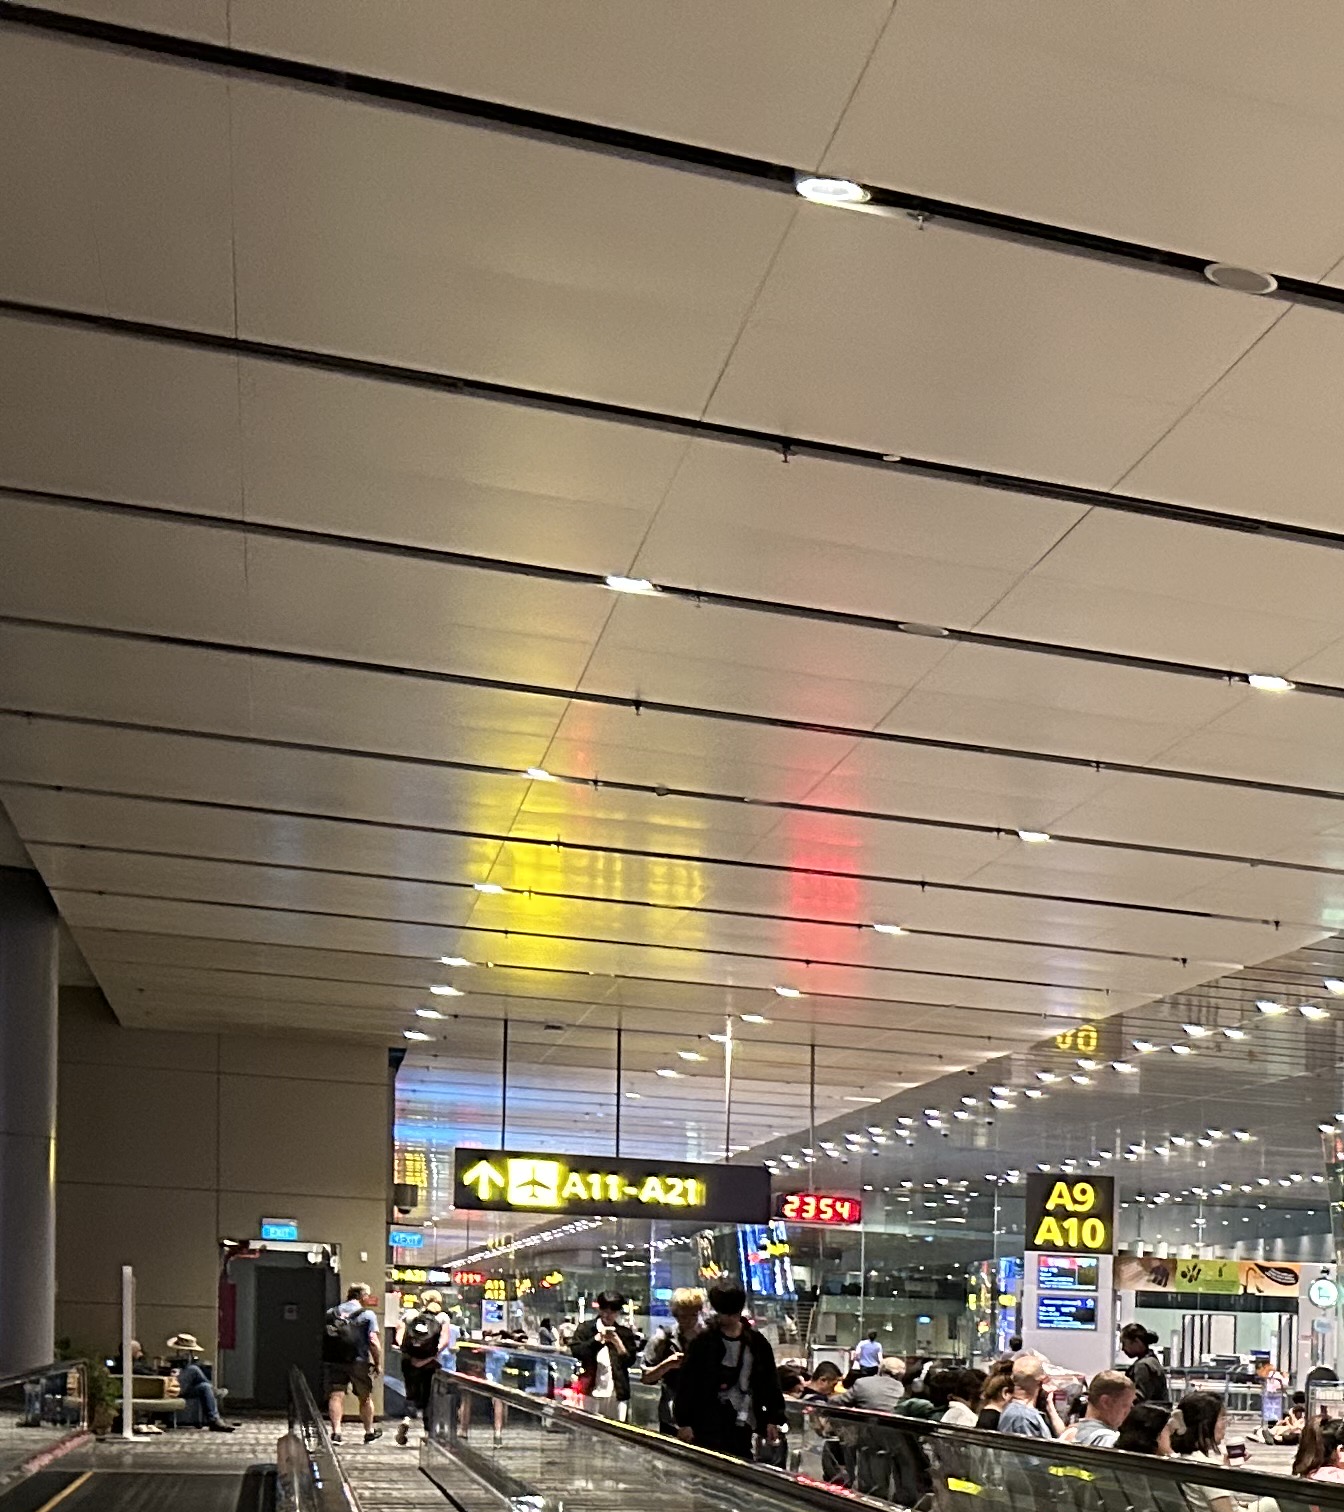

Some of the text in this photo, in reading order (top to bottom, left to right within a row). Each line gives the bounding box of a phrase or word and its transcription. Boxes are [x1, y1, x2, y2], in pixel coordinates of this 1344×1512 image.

[561, 1171, 703, 1206] A11-A21
[1045, 1181, 1095, 1212] A9
[781, 1194, 851, 1220] 2354
[1033, 1215, 1105, 1249] A10
